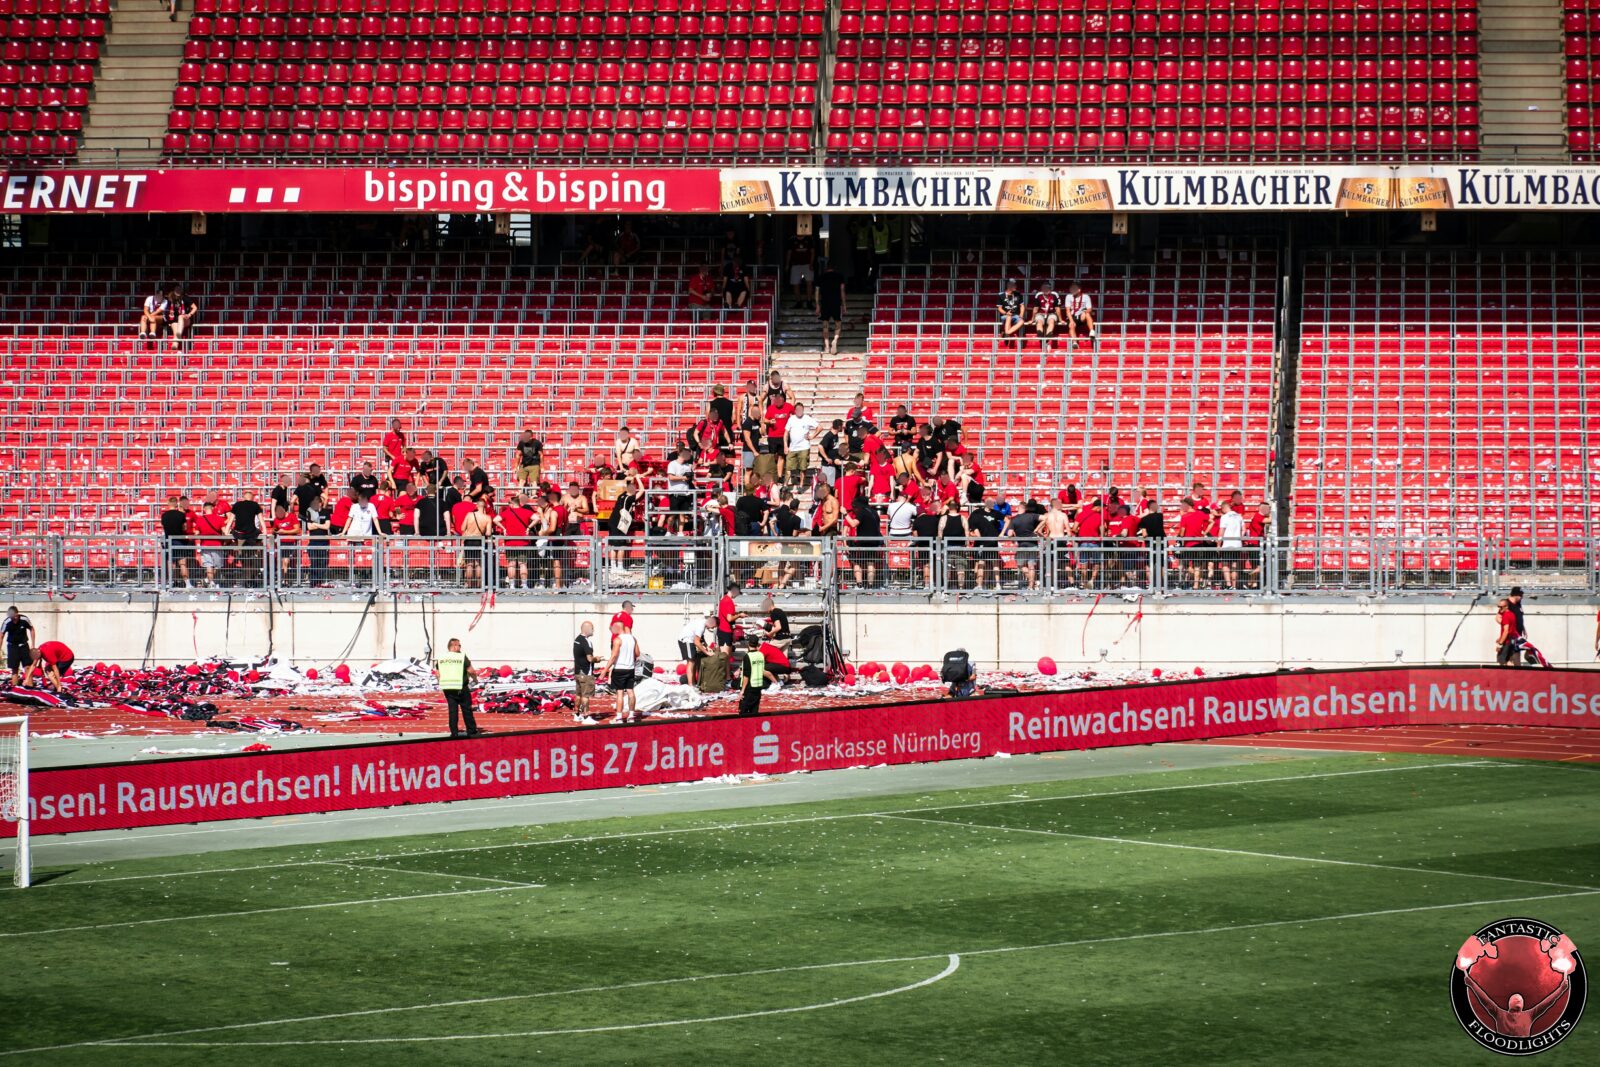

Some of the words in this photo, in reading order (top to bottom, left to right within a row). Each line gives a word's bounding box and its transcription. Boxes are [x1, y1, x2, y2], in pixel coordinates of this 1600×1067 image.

[0, 174, 147, 209] ERNET
[365, 170, 493, 210] bisping
[502, 171, 529, 202] &
[537, 171, 666, 211] bisping
[720, 193, 769, 211] KULMBACHER
[778, 171, 993, 207] KULMBACHER
[1001, 191, 1050, 209] KULMBACHER
[1059, 191, 1107, 209] KULMBACHER
[1117, 170, 1333, 206] KULMBACHER
[1341, 189, 1390, 207] KULMBACHER
[1008, 698, 1195, 741] Reinwachsen!
[1204, 682, 1416, 725] Rauswachsen!
[790, 737, 887, 767] Sparkasse
[893, 728, 981, 754] Nürnberg
[117, 765, 341, 814] Rauswachsen!
[351, 749, 540, 795] Mitwachsen!
[550, 745, 595, 779] Bis
[603, 742, 638, 774] 27
[644, 736, 725, 772] Jahre
